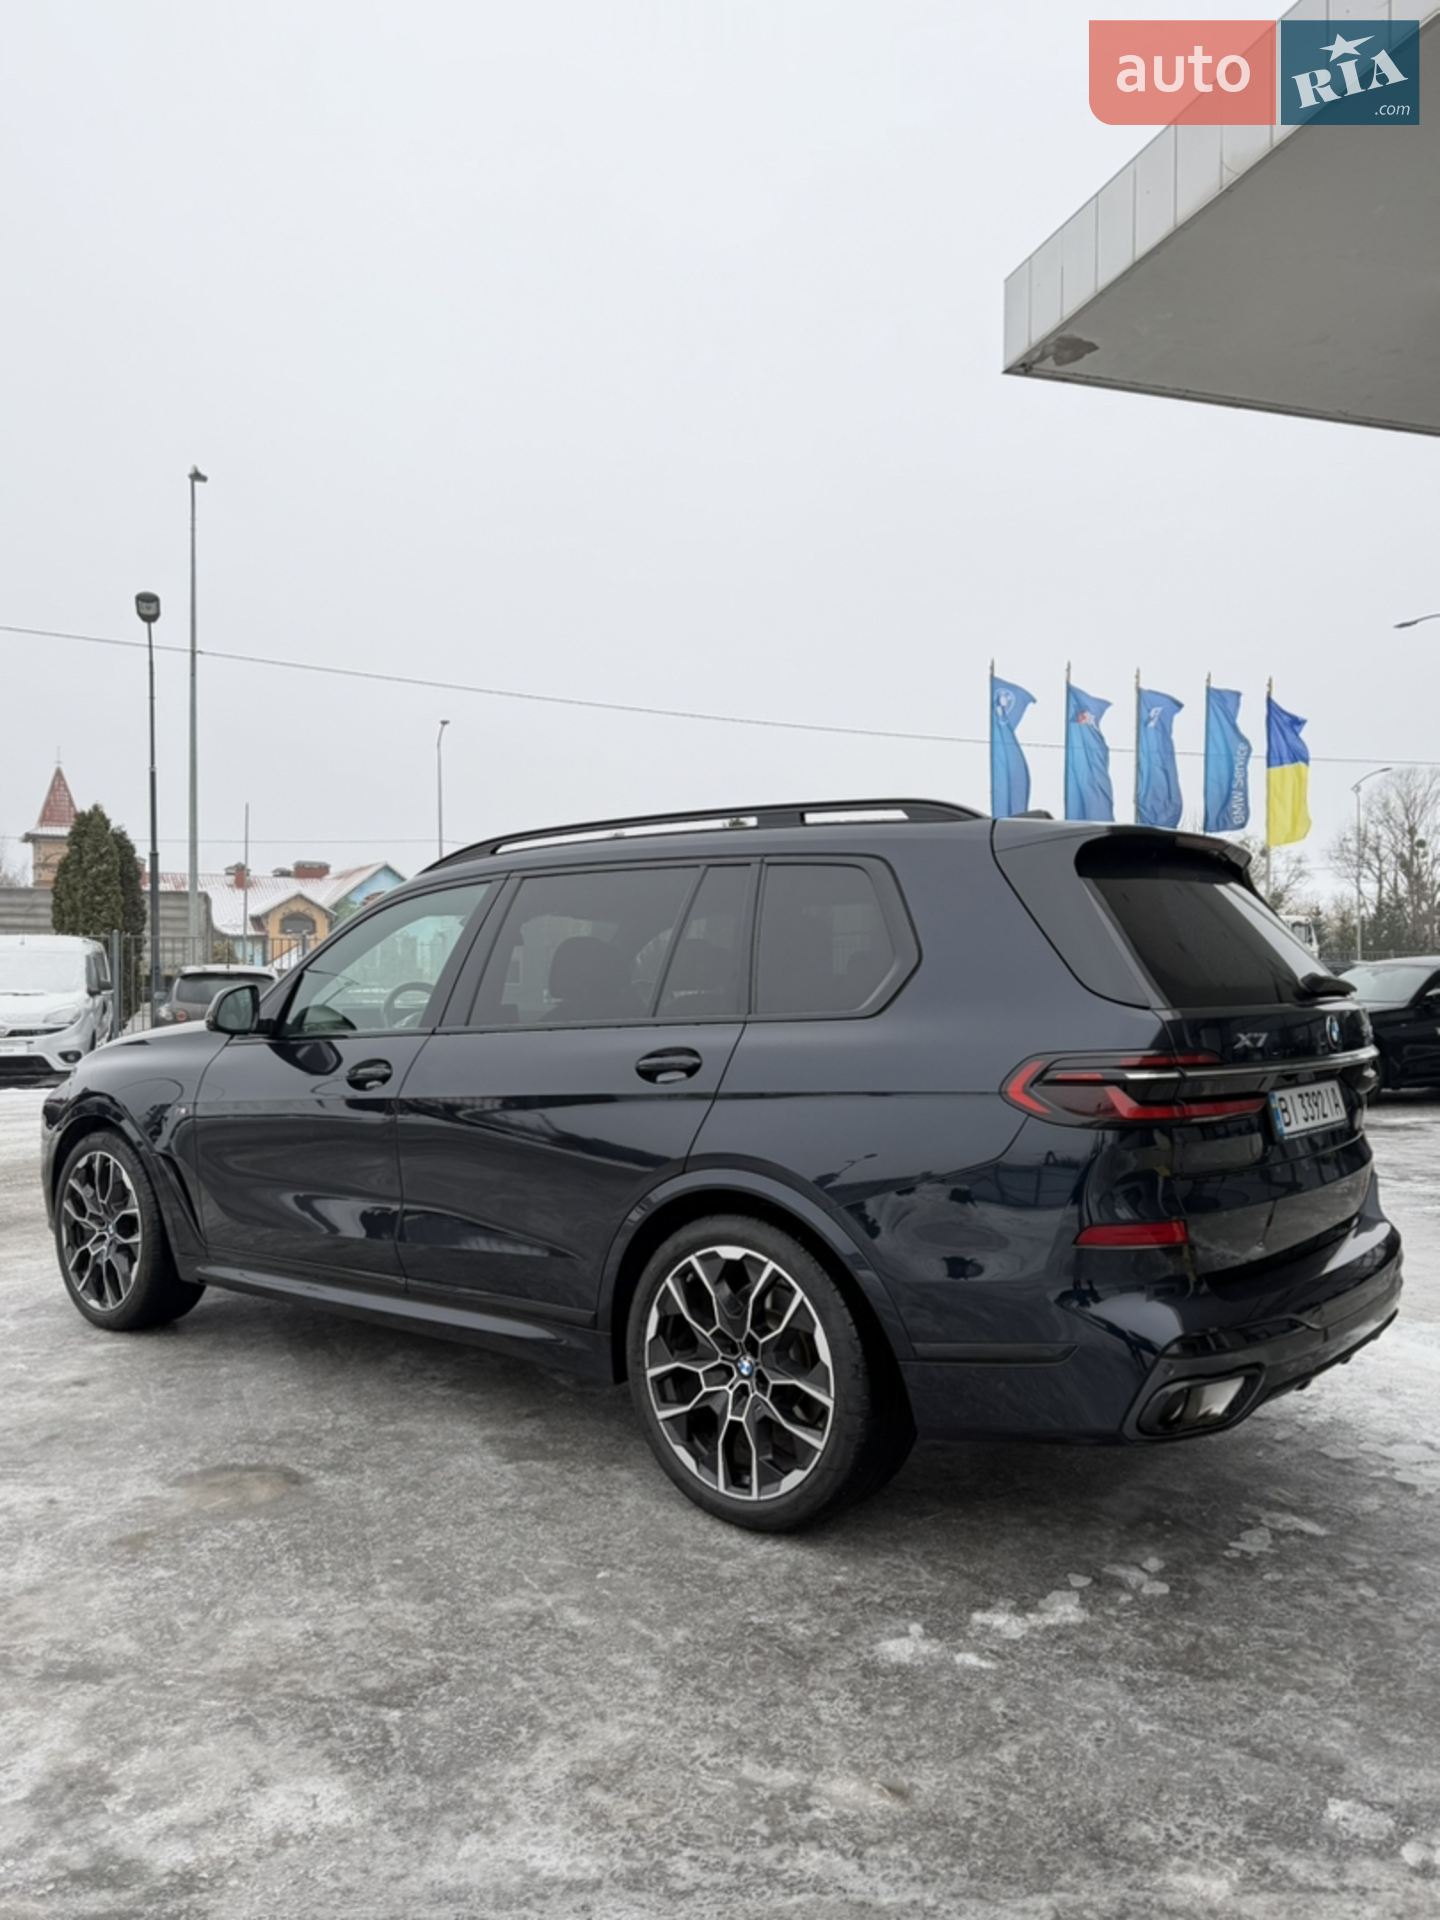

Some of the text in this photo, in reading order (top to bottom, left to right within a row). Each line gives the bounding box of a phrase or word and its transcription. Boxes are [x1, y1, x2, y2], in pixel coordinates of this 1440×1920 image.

[1232, 742, 1249, 825] BMW Service
[1233, 1032, 1269, 1049] X7
[1278, 1096, 1299, 1127] BI
[1297, 1090, 1328, 1122] 3392
